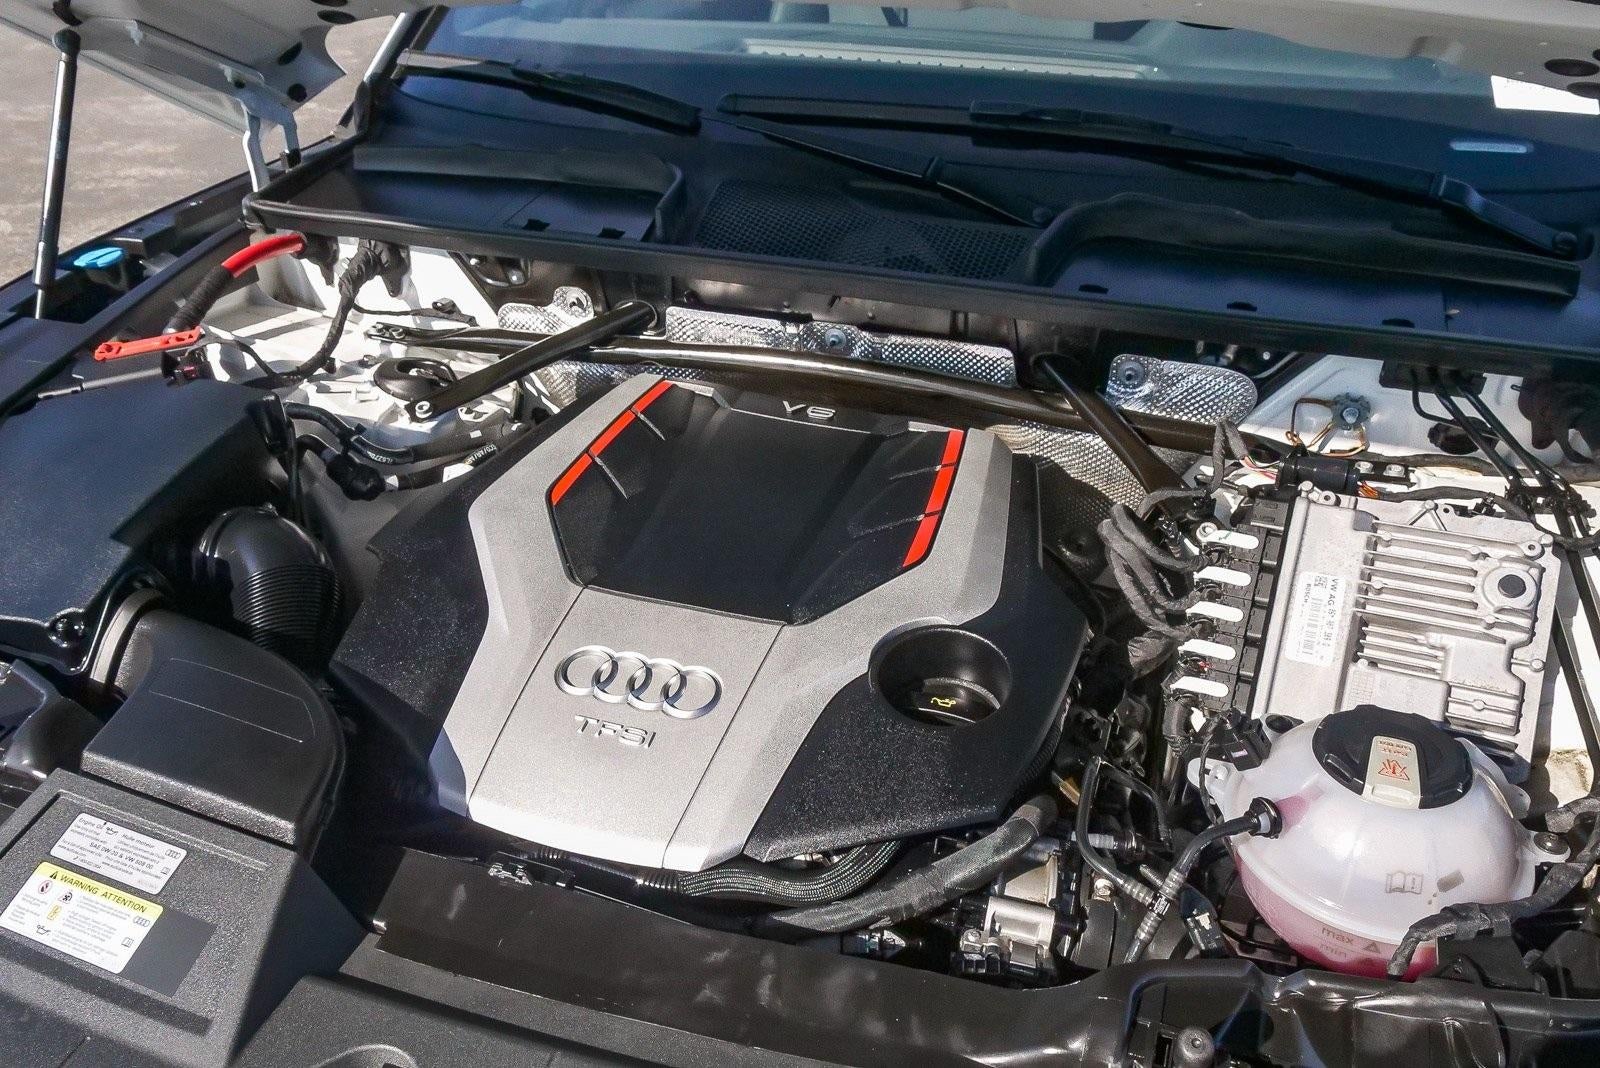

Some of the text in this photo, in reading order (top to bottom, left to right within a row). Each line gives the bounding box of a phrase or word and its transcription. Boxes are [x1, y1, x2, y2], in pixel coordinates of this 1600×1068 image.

[782, 400, 836, 420] V6
[1304, 583, 1312, 603] BOSCH
[1330, 578, 1339, 592] VW
[1328, 594, 1336, 606] AG
[574, 714, 657, 749] TFSI
[79, 817, 95, 828] Engine
[121, 833, 156, 849] Huile moteur
[90, 842, 101, 850] SAE
[124, 855, 136, 863] VW
[60, 874, 99, 895] WARNING
[101, 891, 148, 913] ATTENTION
[1321, 927, 1354, 945] max
